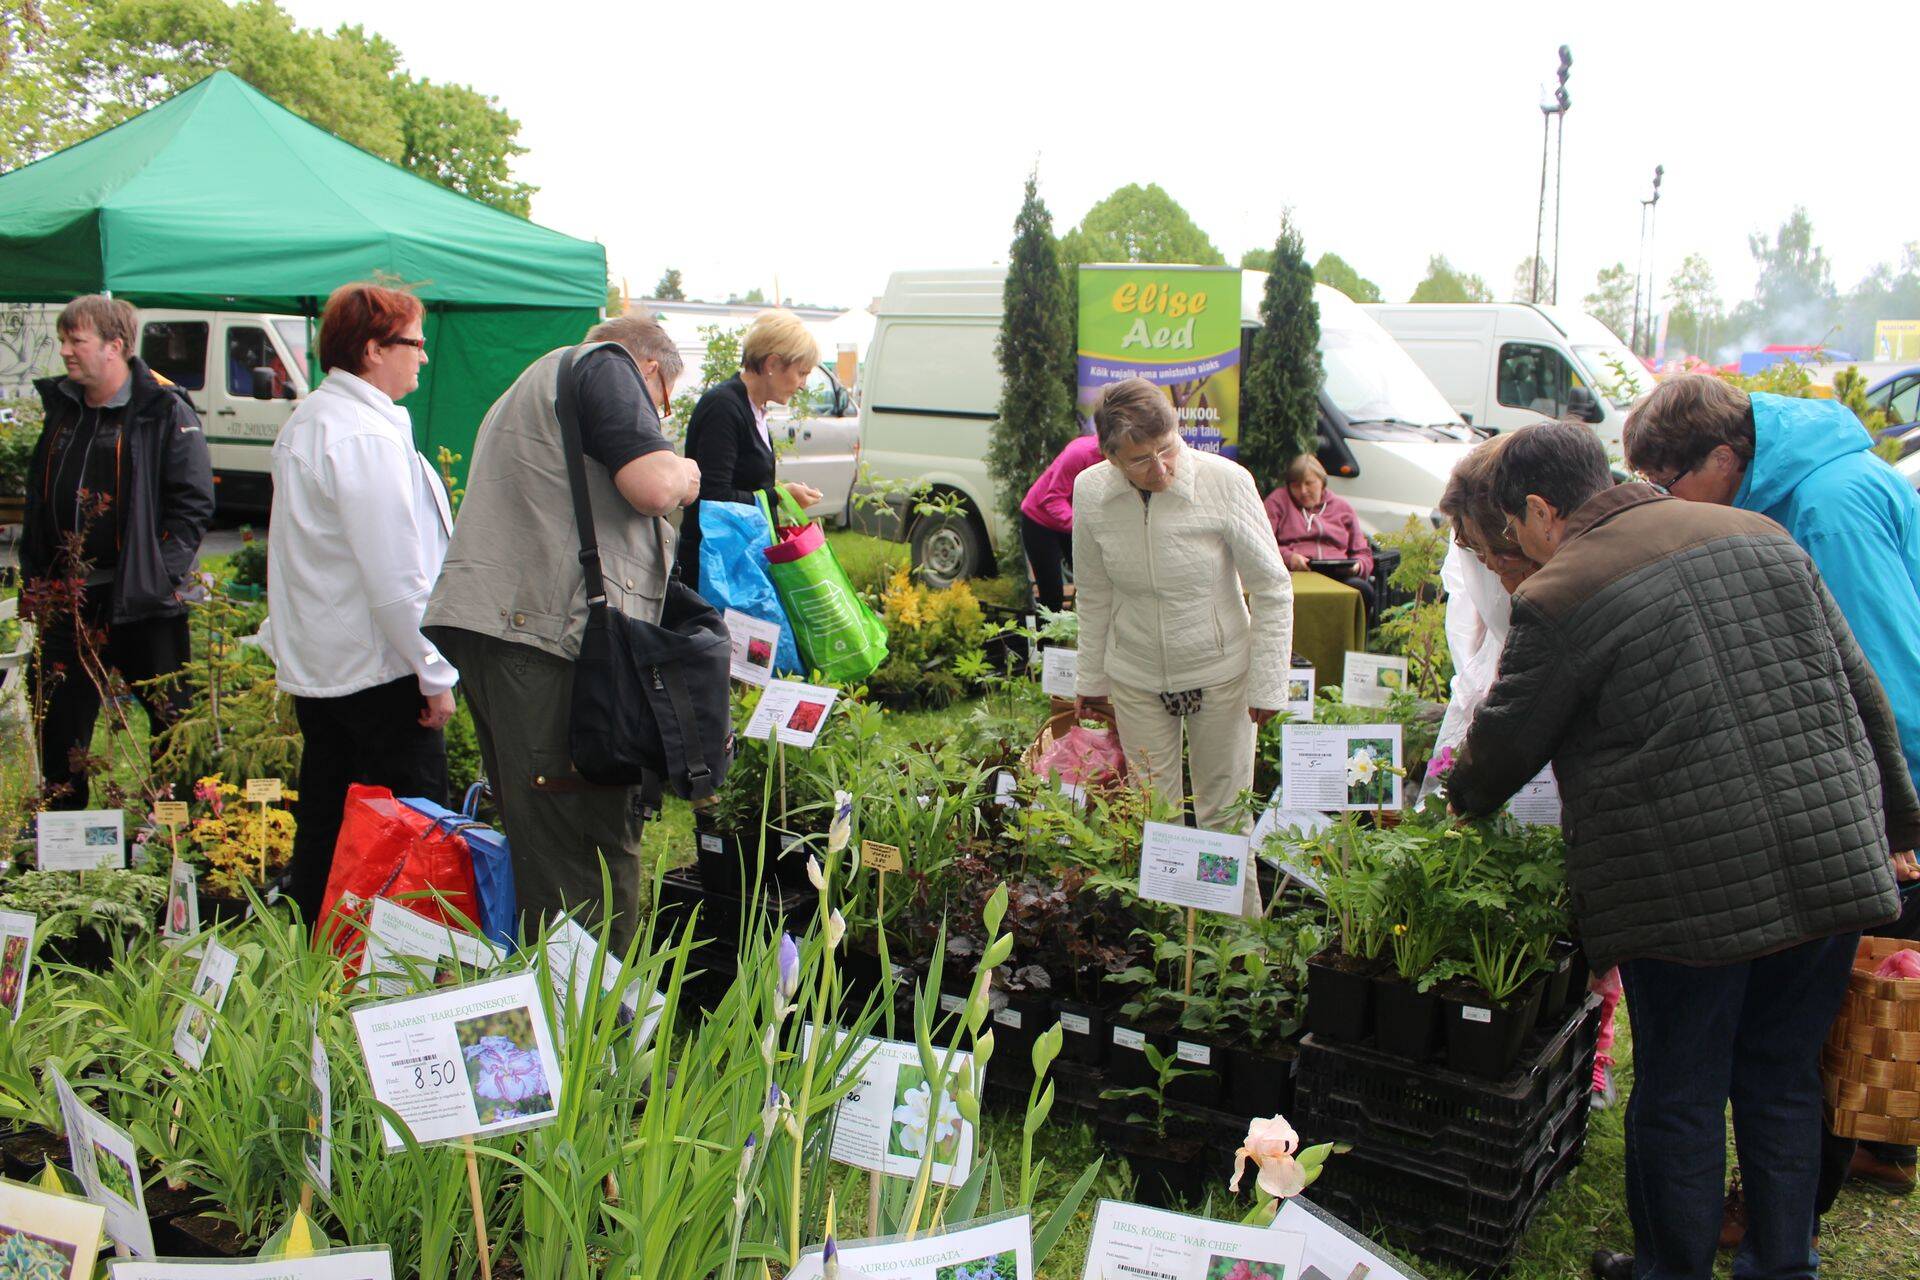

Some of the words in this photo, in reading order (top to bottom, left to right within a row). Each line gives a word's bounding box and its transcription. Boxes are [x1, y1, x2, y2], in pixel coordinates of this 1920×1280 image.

[1113, 282, 1207, 317] Elise
[1121, 317, 1196, 349] Aed
[1090, 365, 1108, 377] Kõik
[1139, 370, 1158, 378] oma
[1159, 364, 1197, 377] unistuste
[1200, 424, 1220, 437] talu
[1198, 441, 1219, 453] vald
[1142, 1223, 1176, 1241] KÕRGE
